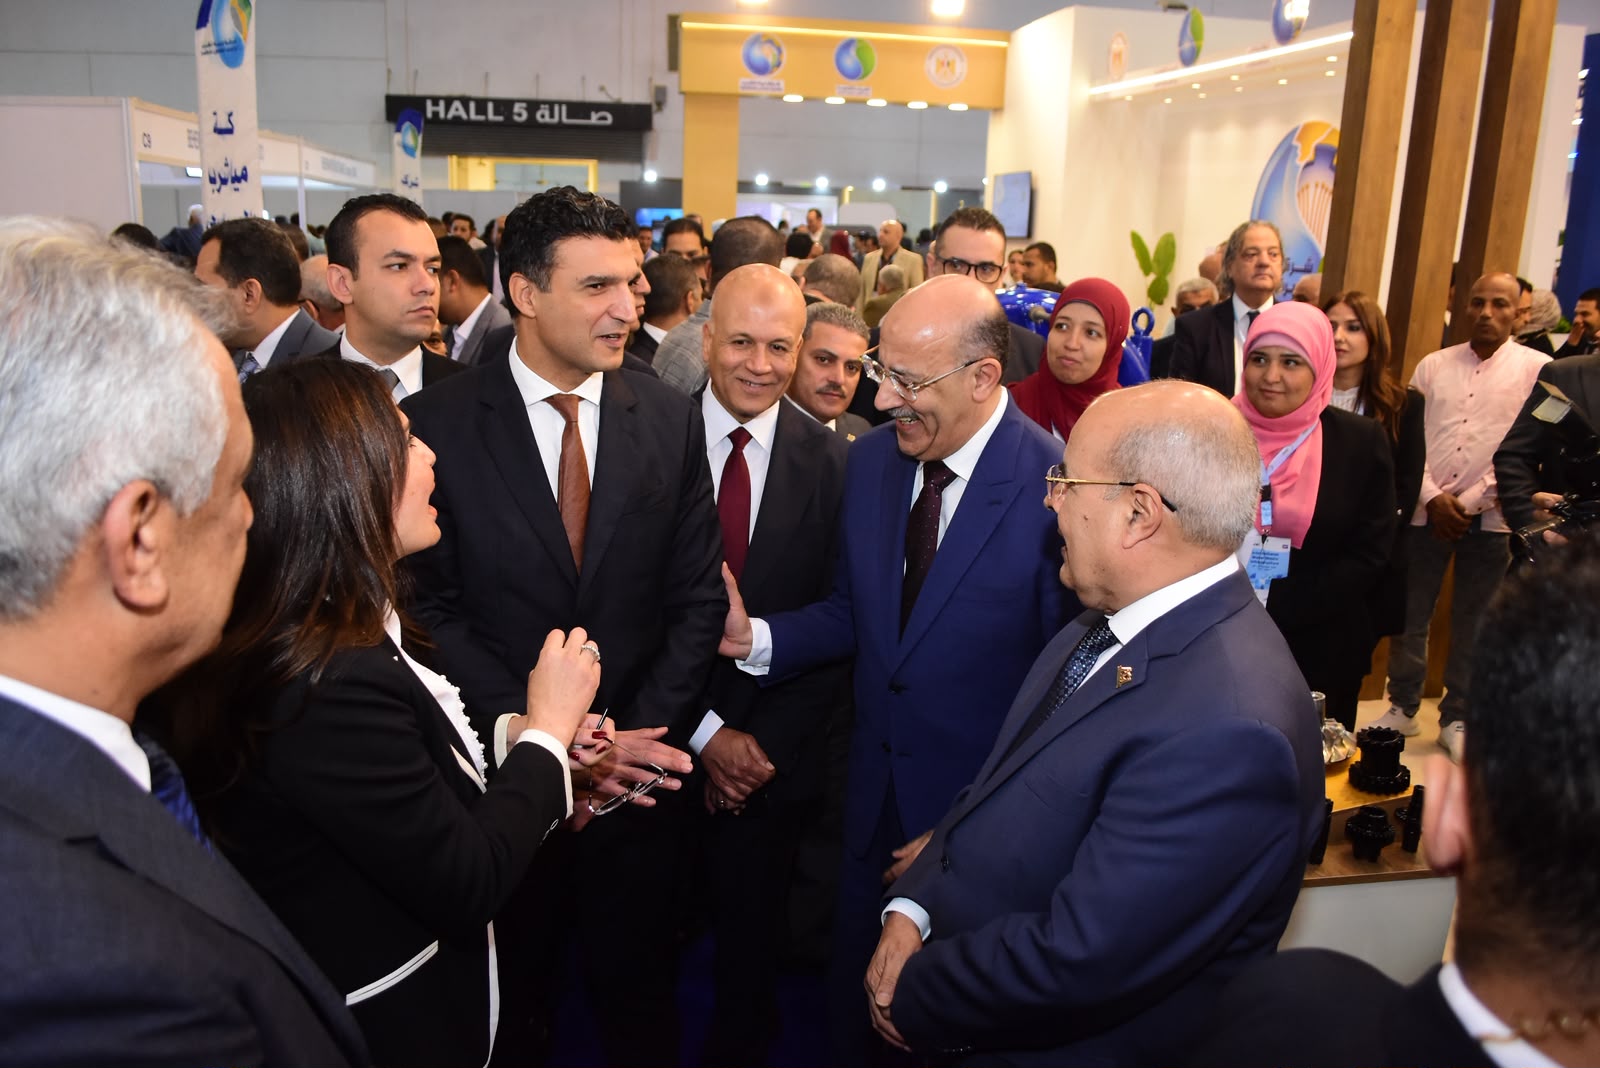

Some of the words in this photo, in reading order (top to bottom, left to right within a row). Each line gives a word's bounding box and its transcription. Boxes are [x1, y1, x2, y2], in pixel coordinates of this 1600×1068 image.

[425, 98, 504, 122] HALL
[512, 102, 529, 123] 5
[535, 103, 614, 126] صالة
